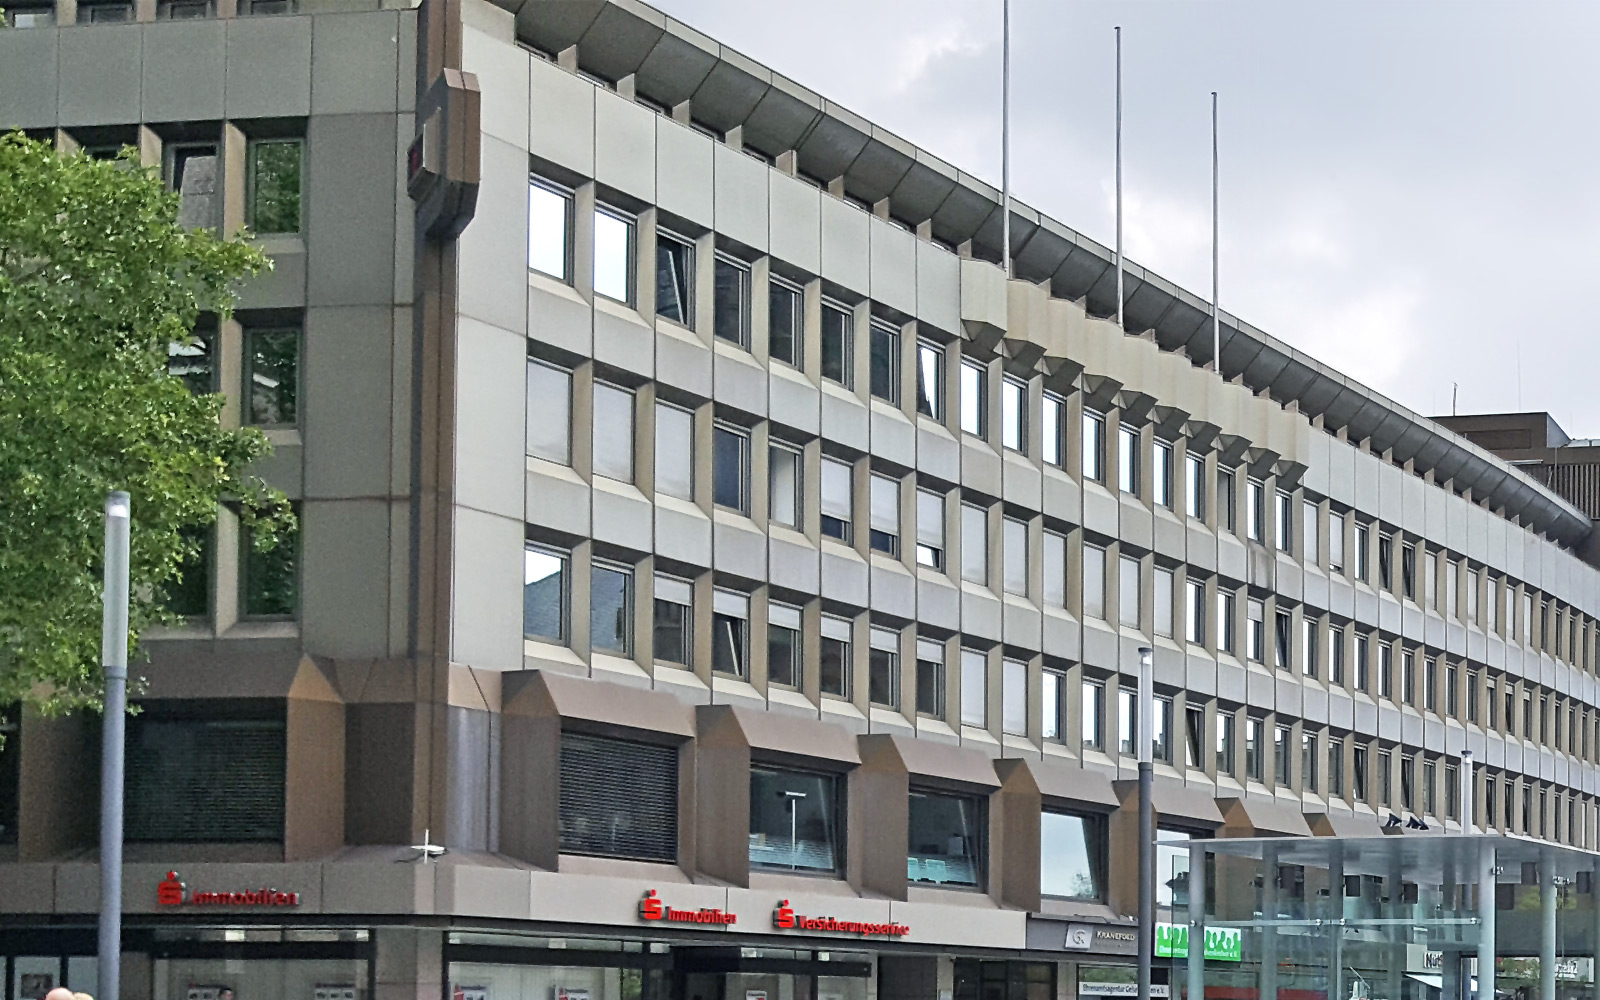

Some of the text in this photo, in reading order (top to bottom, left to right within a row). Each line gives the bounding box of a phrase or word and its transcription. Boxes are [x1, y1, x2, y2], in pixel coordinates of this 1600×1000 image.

[193, 886, 299, 905] Immobilien
[665, 905, 737, 925] Immobilien
[796, 915, 910, 936] Versicherungsservice
